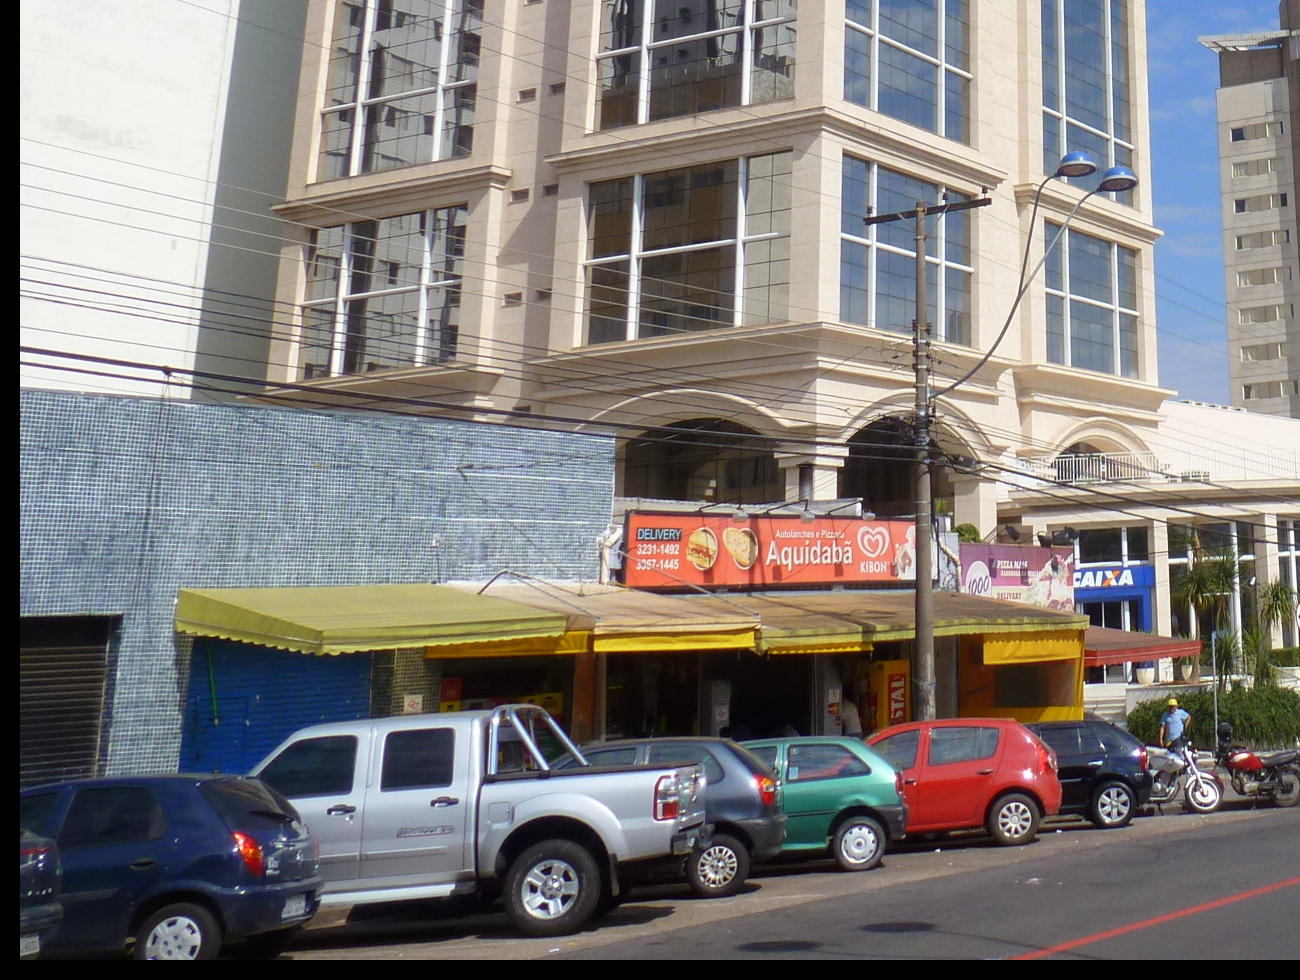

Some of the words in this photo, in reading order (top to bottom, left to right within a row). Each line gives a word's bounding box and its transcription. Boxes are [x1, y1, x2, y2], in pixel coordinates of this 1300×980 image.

[637, 528, 681, 540] DELIVERY
[775, 529, 814, 539] Autolanches
[636, 543, 680, 555] 3231-1492
[766, 540, 853, 571] Aquidabã
[860, 561, 887, 573] KIBON
[997, 560, 1013, 569] PIZZA
[1073, 569, 1133, 587] CAIXA
[891, 677, 905, 721] STAL
